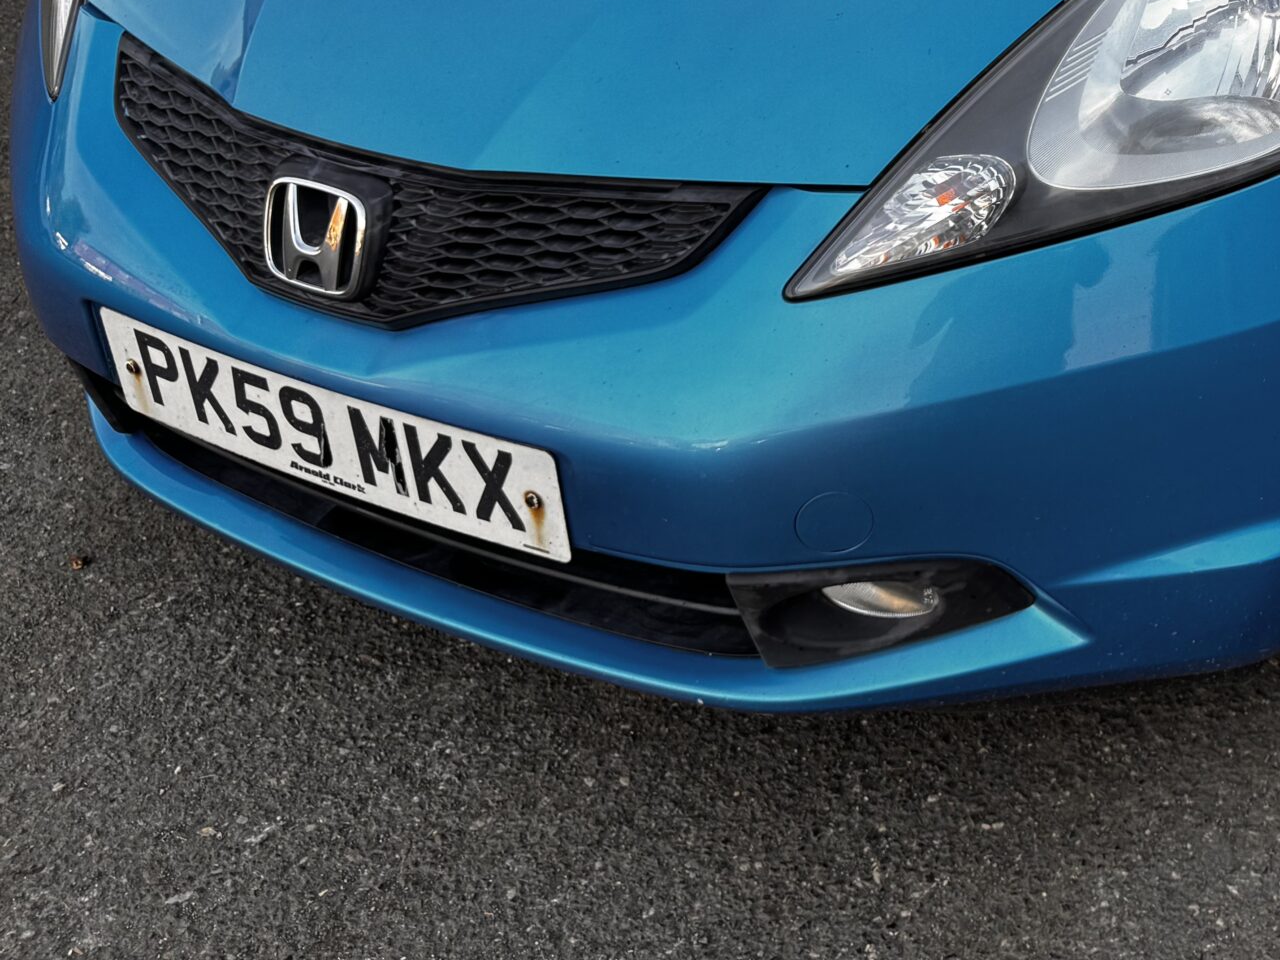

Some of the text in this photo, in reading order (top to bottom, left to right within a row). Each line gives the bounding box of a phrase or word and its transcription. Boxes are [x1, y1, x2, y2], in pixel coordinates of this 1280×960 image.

[133, 328, 526, 533] PK59 MKX
[290, 460, 367, 494] Arnold Clark
